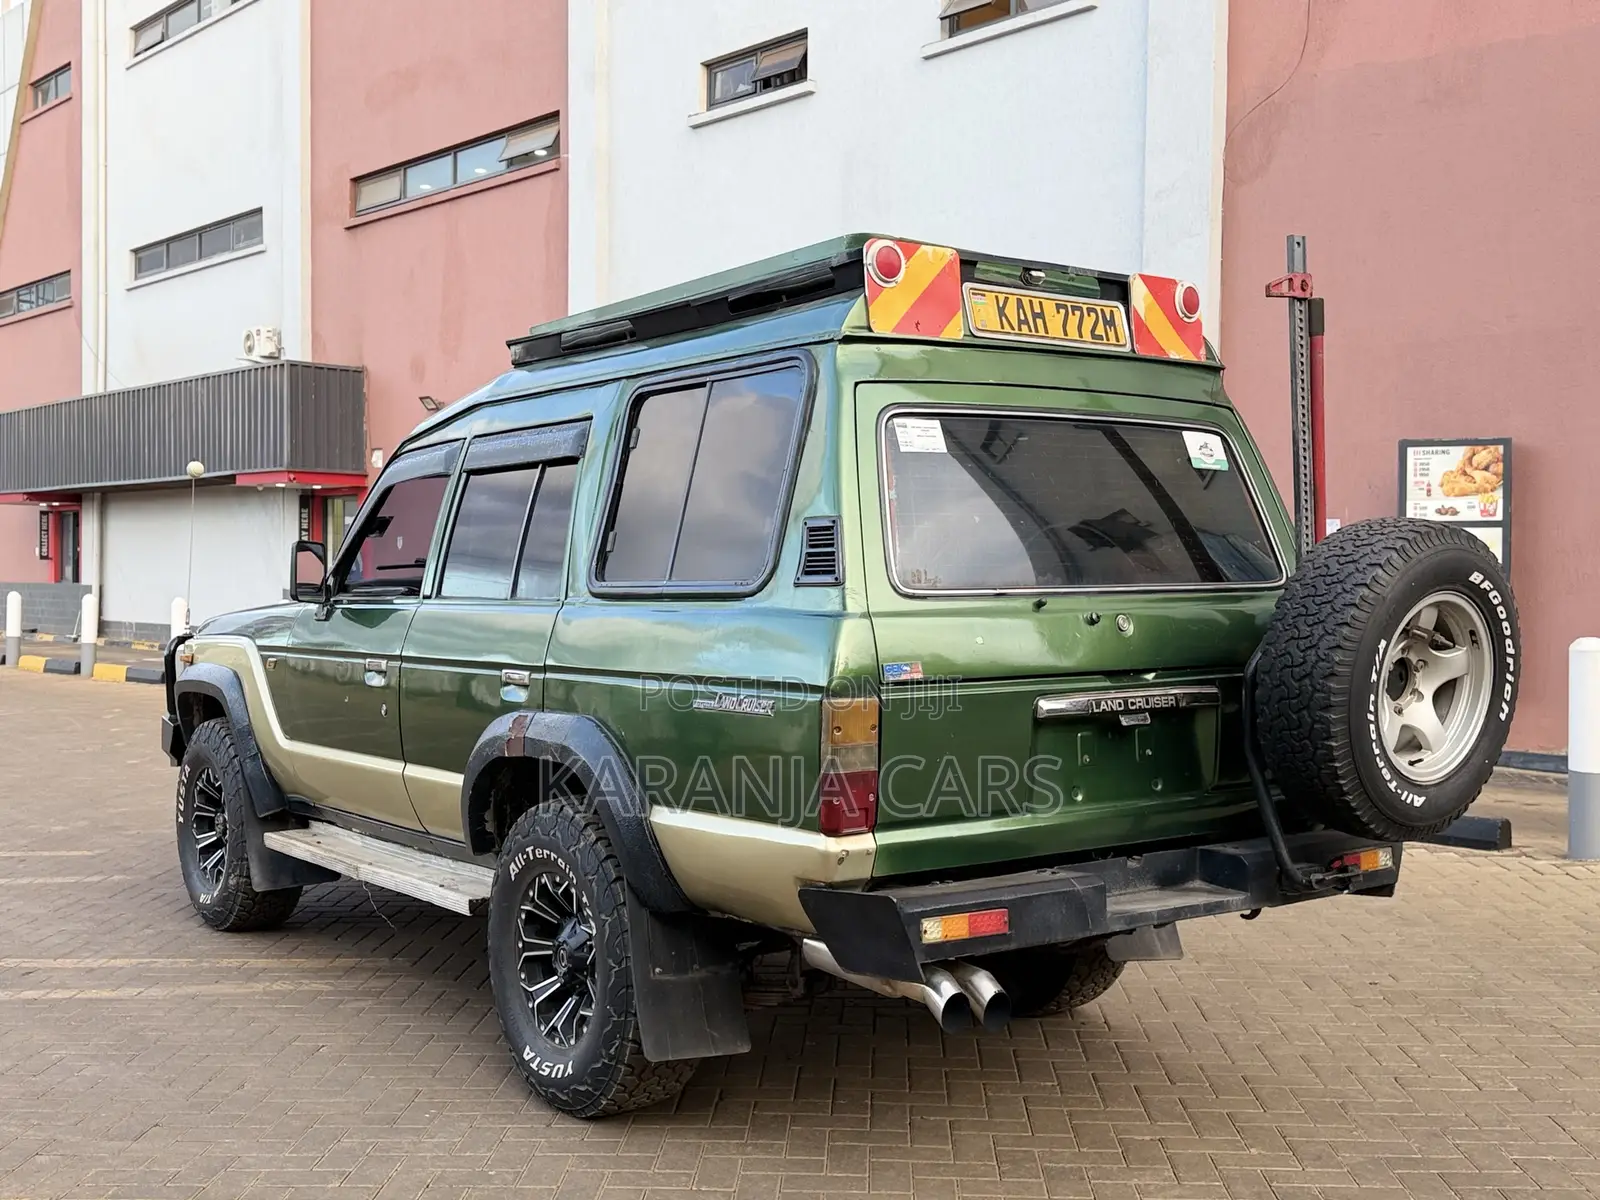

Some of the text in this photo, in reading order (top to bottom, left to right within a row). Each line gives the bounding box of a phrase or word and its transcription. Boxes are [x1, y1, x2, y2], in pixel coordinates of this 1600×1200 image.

[994, 295, 1121, 343] KAH 772M
[301, 507, 309, 529] HERE
[1468, 571, 1515, 723] BFGoodrich
[1092, 696, 1177, 713] LAND CRUISER
[1367, 639, 1427, 808] All-Terrain T/A
[178, 764, 191, 824] YUSTA
[508, 845, 577, 885] All-Terrain
[522, 1044, 574, 1079] YUSTA
